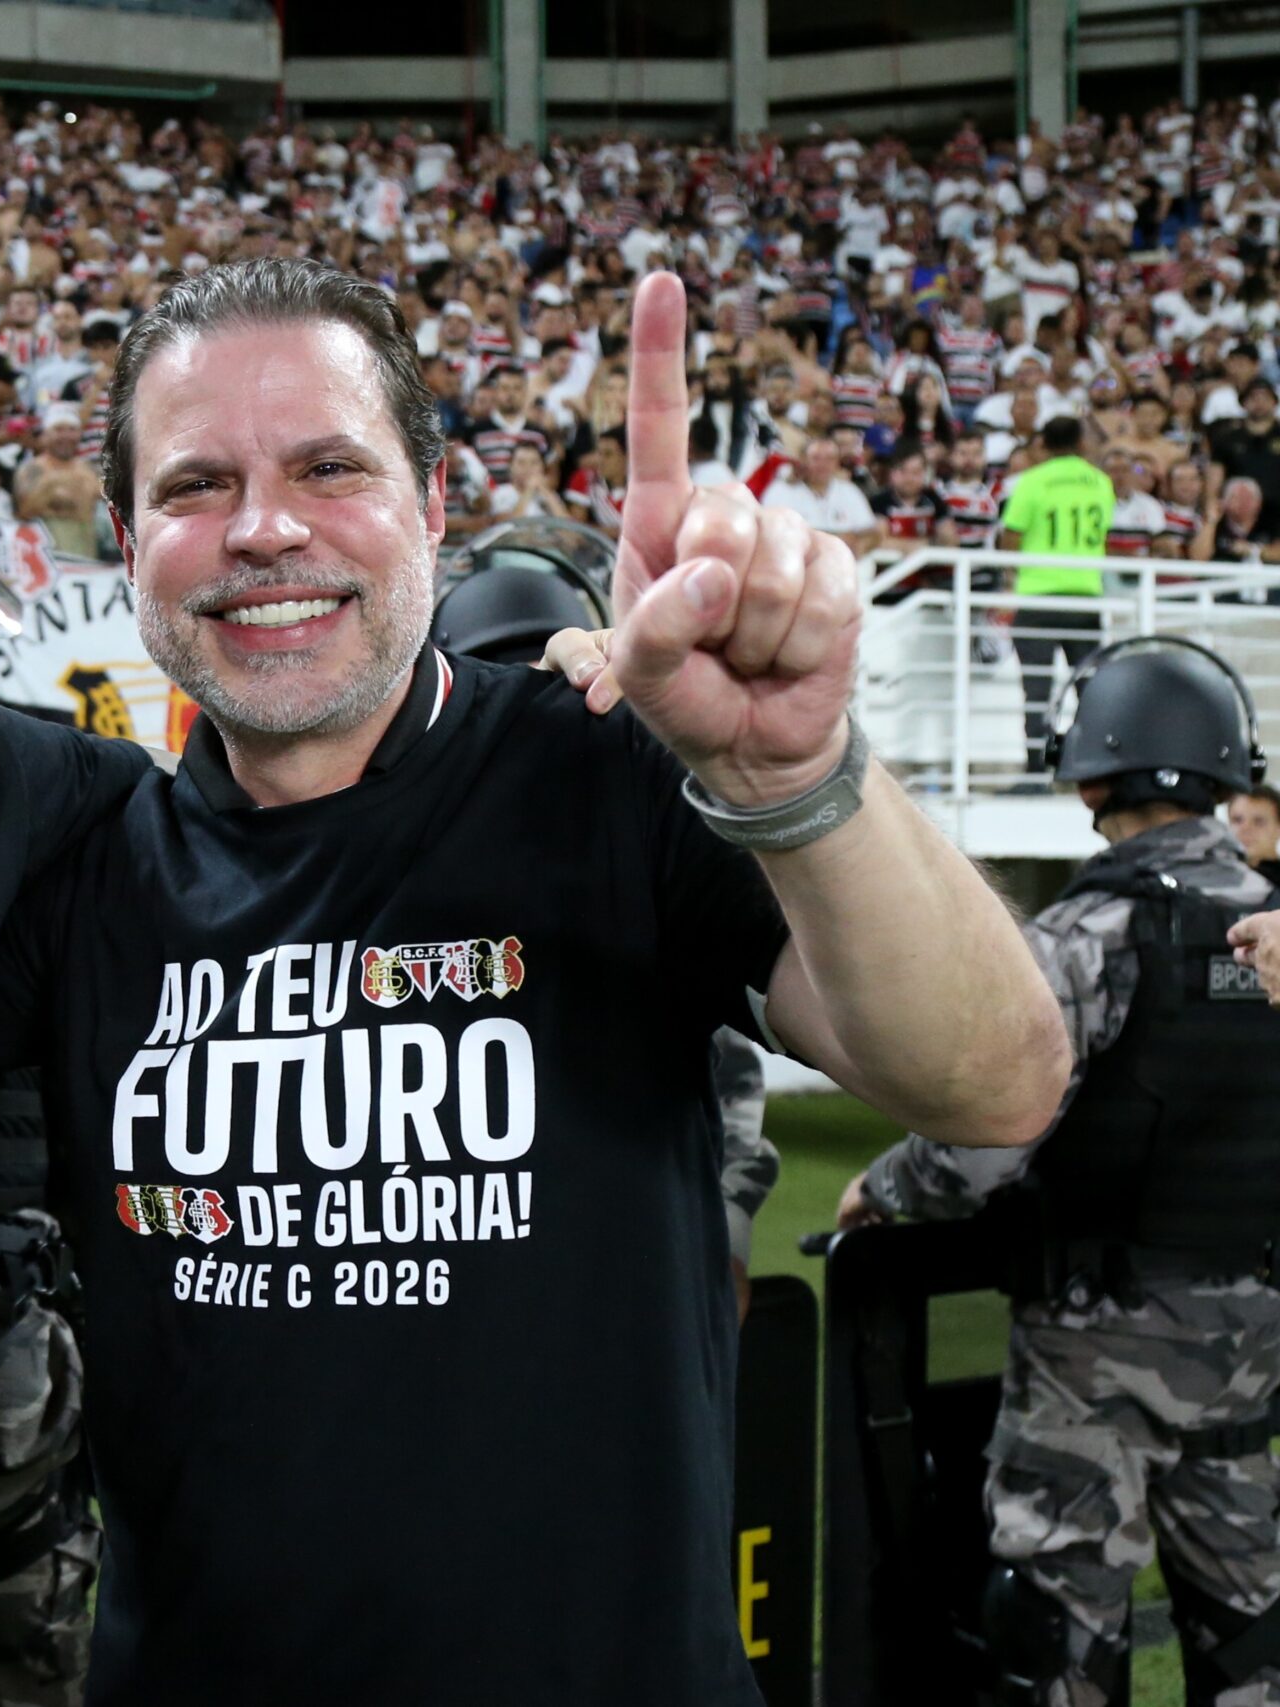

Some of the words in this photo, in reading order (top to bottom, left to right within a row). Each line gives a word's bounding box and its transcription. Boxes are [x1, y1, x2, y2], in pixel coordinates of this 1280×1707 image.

[1047, 503, 1104, 549] 113
[143, 958, 225, 1046] AO
[237, 939, 357, 1033] TEU
[112, 1017, 536, 1176] FUTURO
[236, 1183, 302, 1248] DE
[314, 1164, 533, 1248] GLÓRIA!
[174, 1252, 273, 1308] SÉRIE
[287, 1263, 312, 1309] C
[334, 1258, 450, 1306] 2026
